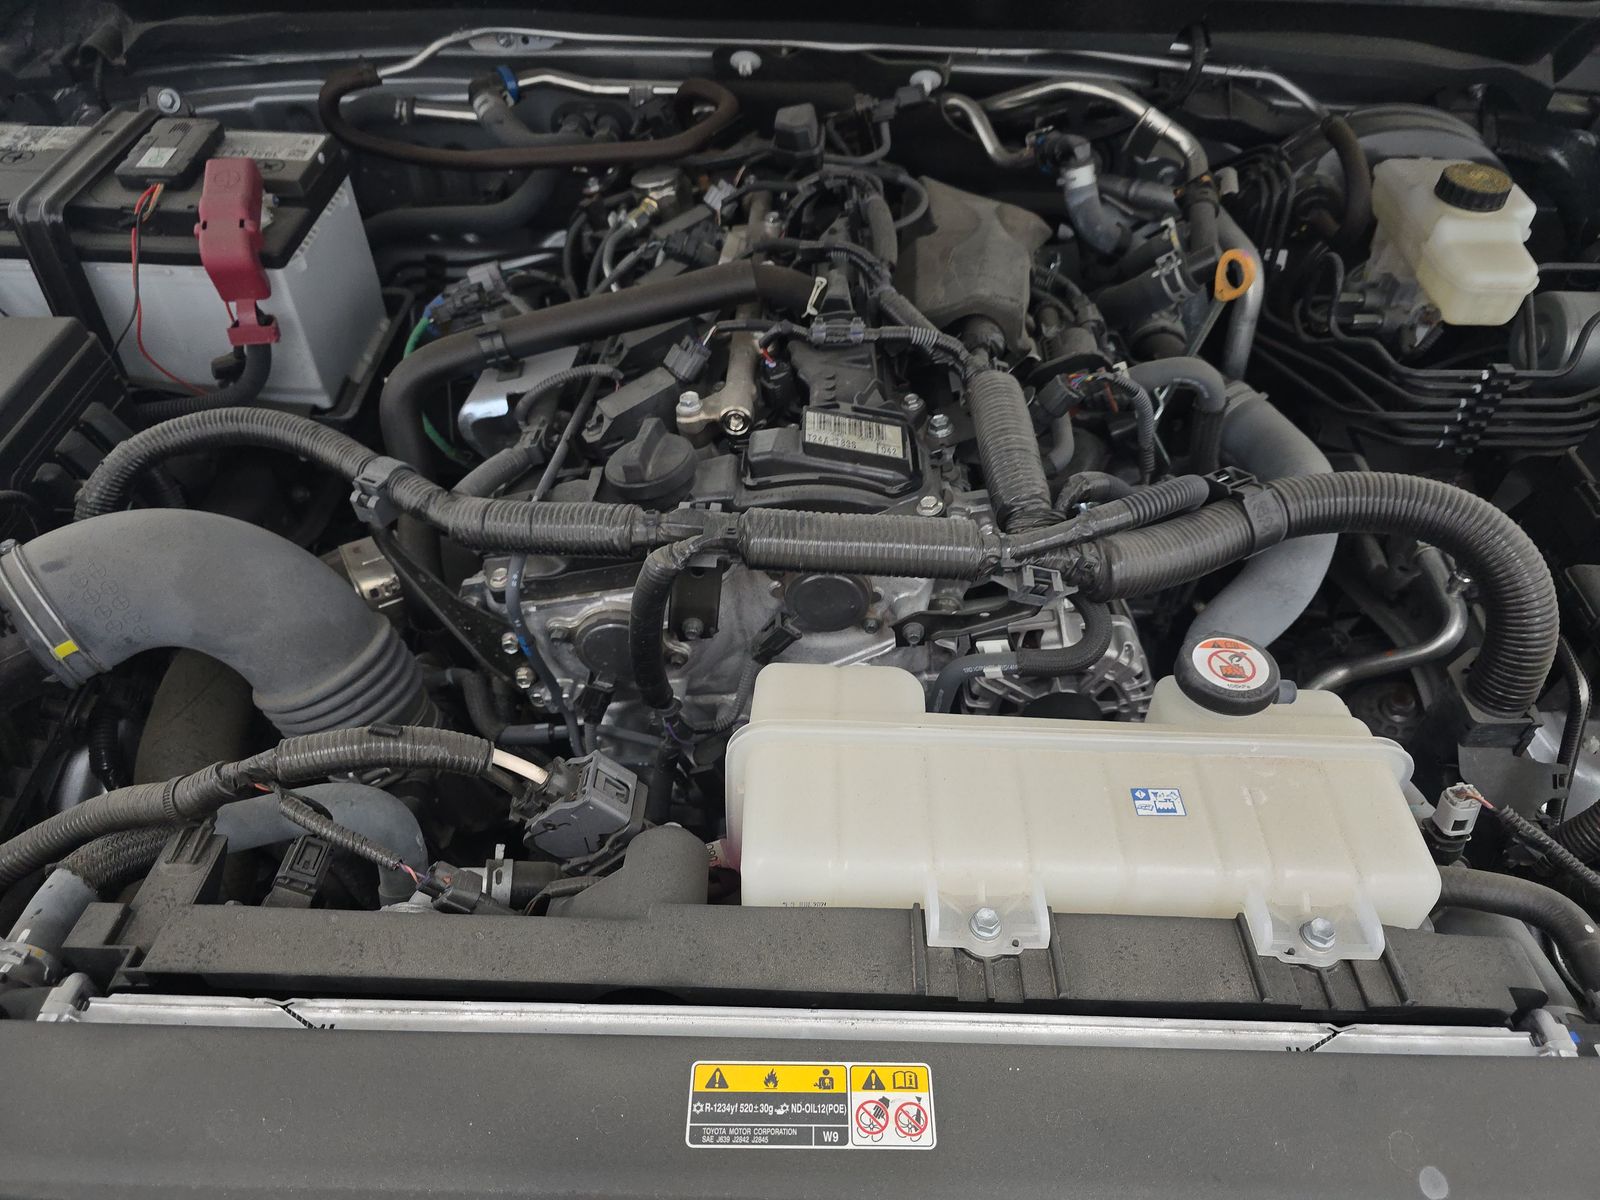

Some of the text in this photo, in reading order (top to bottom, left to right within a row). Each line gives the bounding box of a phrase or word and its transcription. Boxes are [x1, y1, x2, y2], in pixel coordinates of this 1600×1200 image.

[704, 1103, 847, 1115] R-1234yf 520±30g ND-OIL12(POE)
[703, 1127, 798, 1136] TOYOTA MOTOR CORPORATION
[822, 1131, 839, 1142] W9
[702, 1135, 714, 1143] SAE
[716, 1135, 730, 1143] J639
